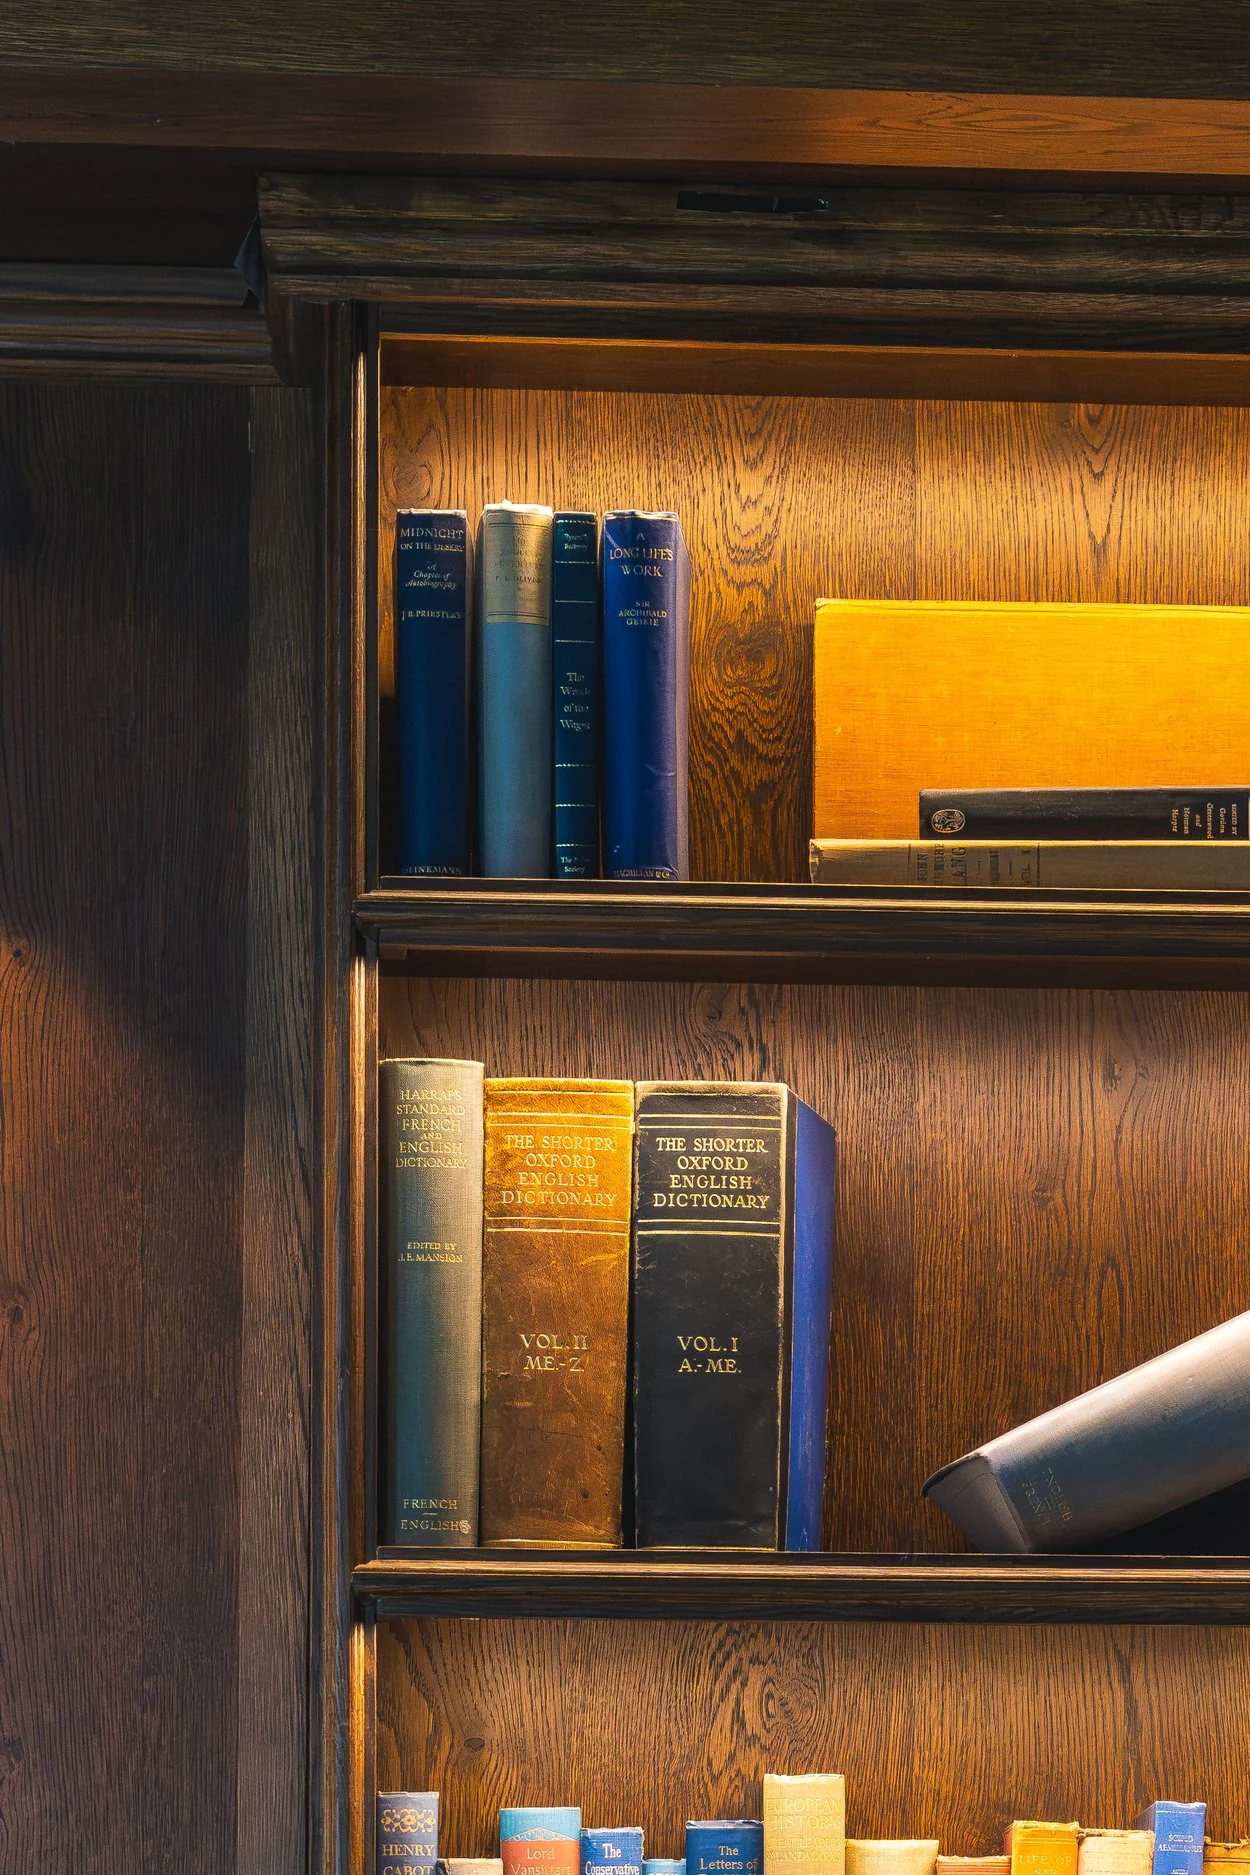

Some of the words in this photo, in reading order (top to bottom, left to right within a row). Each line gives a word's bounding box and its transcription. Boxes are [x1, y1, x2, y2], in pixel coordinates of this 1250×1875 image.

[400, 528, 464, 539] MIDNIGHT
[609, 548, 640, 561] LONG
[643, 548, 673, 561] LIFE'S
[621, 565, 662, 577] WORK
[401, 1090, 461, 1101] HARRAP'S
[396, 1104, 466, 1116] STANDARD
[402, 1119, 461, 1132] FRENCH
[399, 1141, 463, 1154] ENGLISH
[505, 1135, 537, 1148] THE
[542, 1136, 613, 1152] SHORTER
[656, 1137, 686, 1152] THE
[694, 1138, 768, 1152] SHORTER
[396, 1157, 467, 1169] DICTIONARY
[526, 1154, 595, 1168] OXFORD
[677, 1156, 748, 1170] OXFORD
[518, 1171, 599, 1186] ENGLISH
[670, 1175, 752, 1189] ENGLISH
[501, 1190, 617, 1207] DICTIONARY
[653, 1193, 770, 1209] DICTIONARY
[382, 1843, 434, 1858] HENRY
[526, 1847, 555, 1861] Lord
[602, 1843, 622, 1858] The
[718, 1845, 738, 1857] The
[699, 1858, 742, 1871] Letters
[746, 1858, 757, 1871] of
